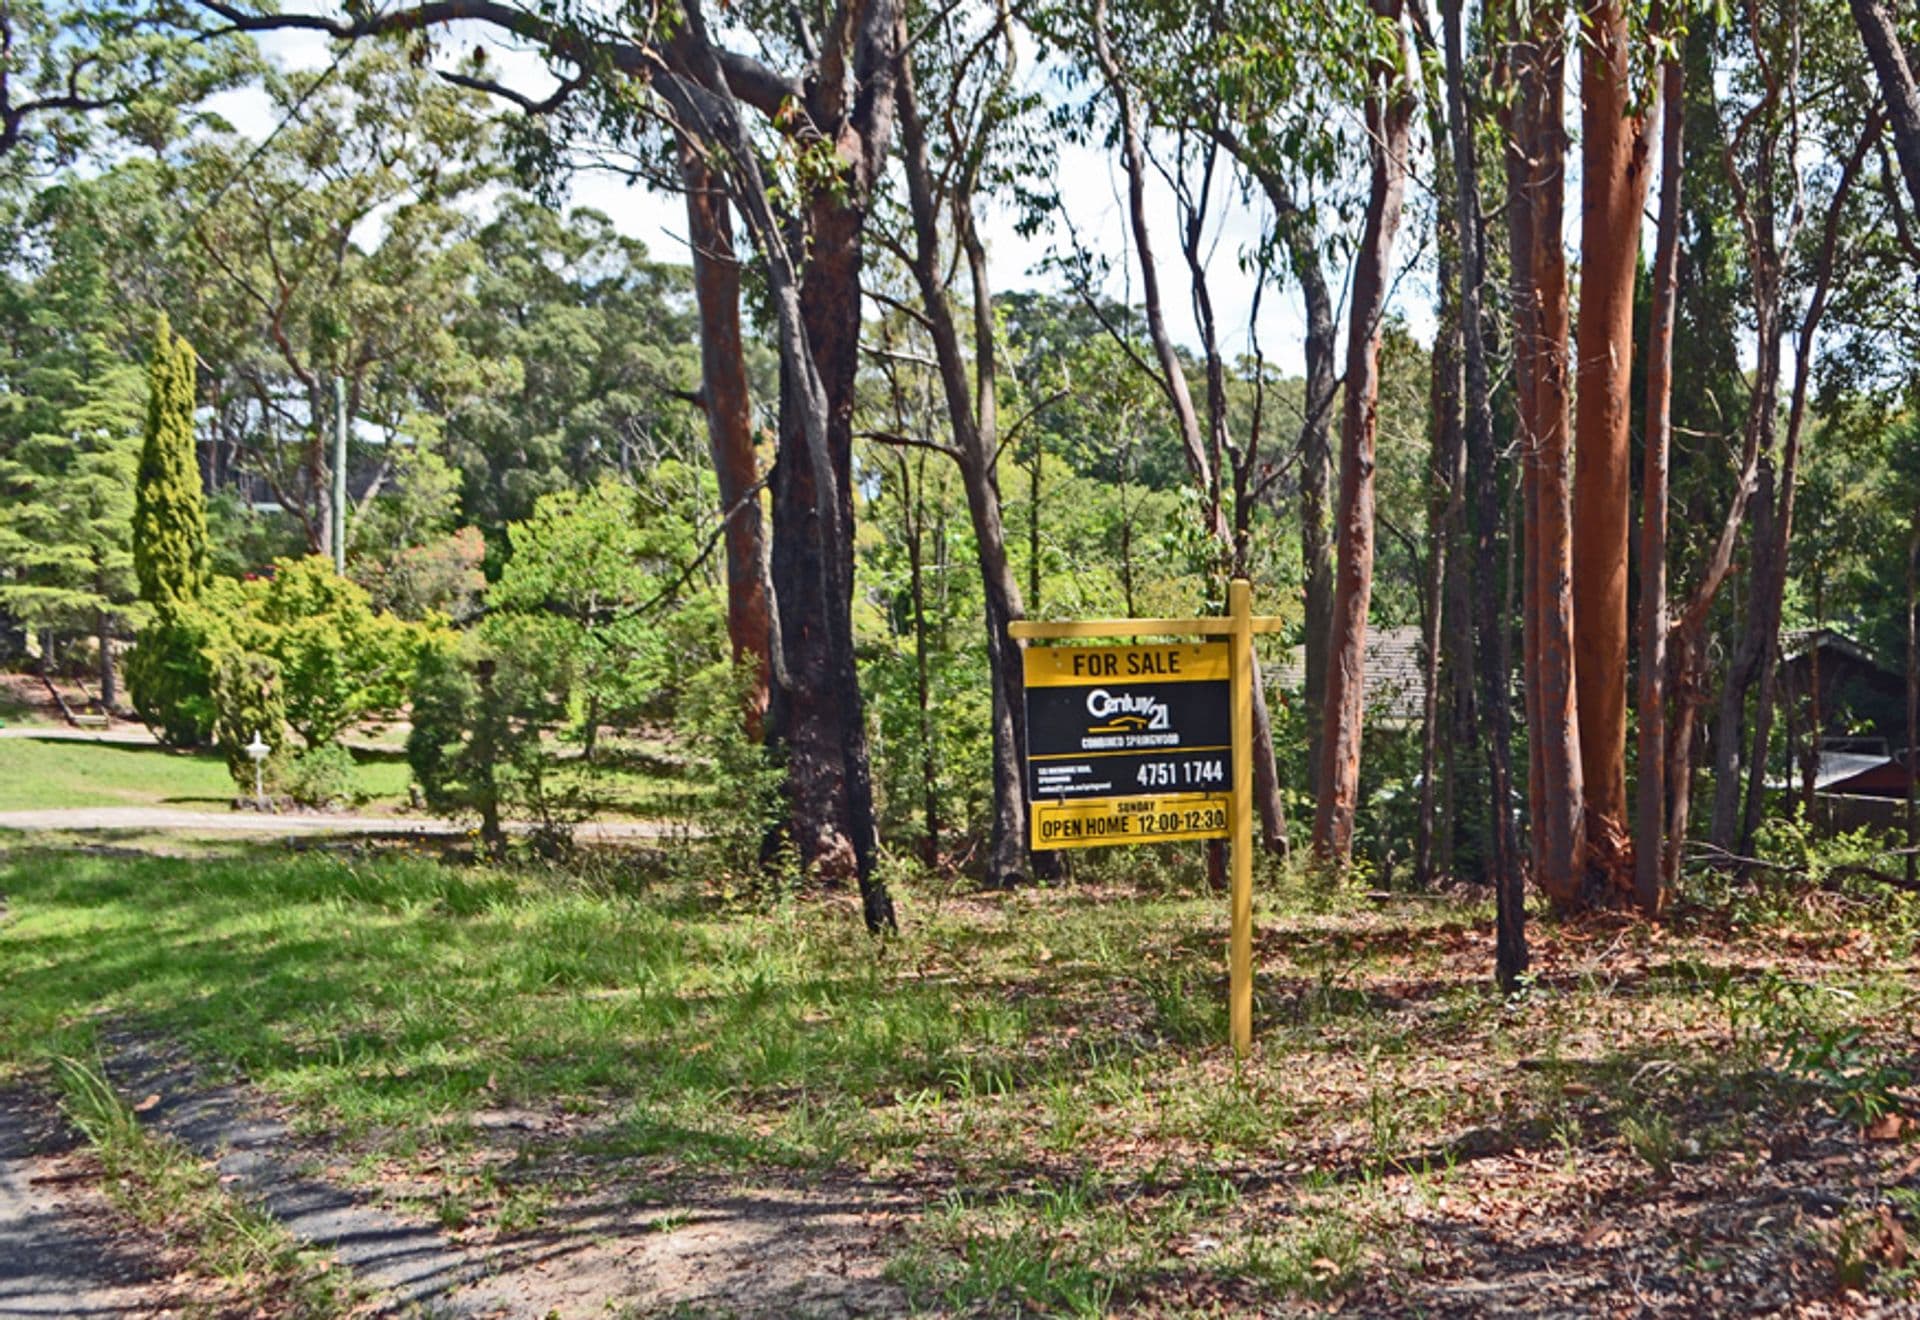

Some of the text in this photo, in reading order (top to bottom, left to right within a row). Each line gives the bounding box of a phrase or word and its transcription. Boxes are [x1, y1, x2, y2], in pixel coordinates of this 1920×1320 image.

[1073, 651, 1181, 676] FOR SALE
[1147, 704, 1172, 730] 21
[1136, 760, 1223, 787] 4751 1744
[1117, 801, 1156, 814] SUNDAY
[1042, 818, 1082, 838] OPEN
[1086, 816, 1129, 834] HOME
